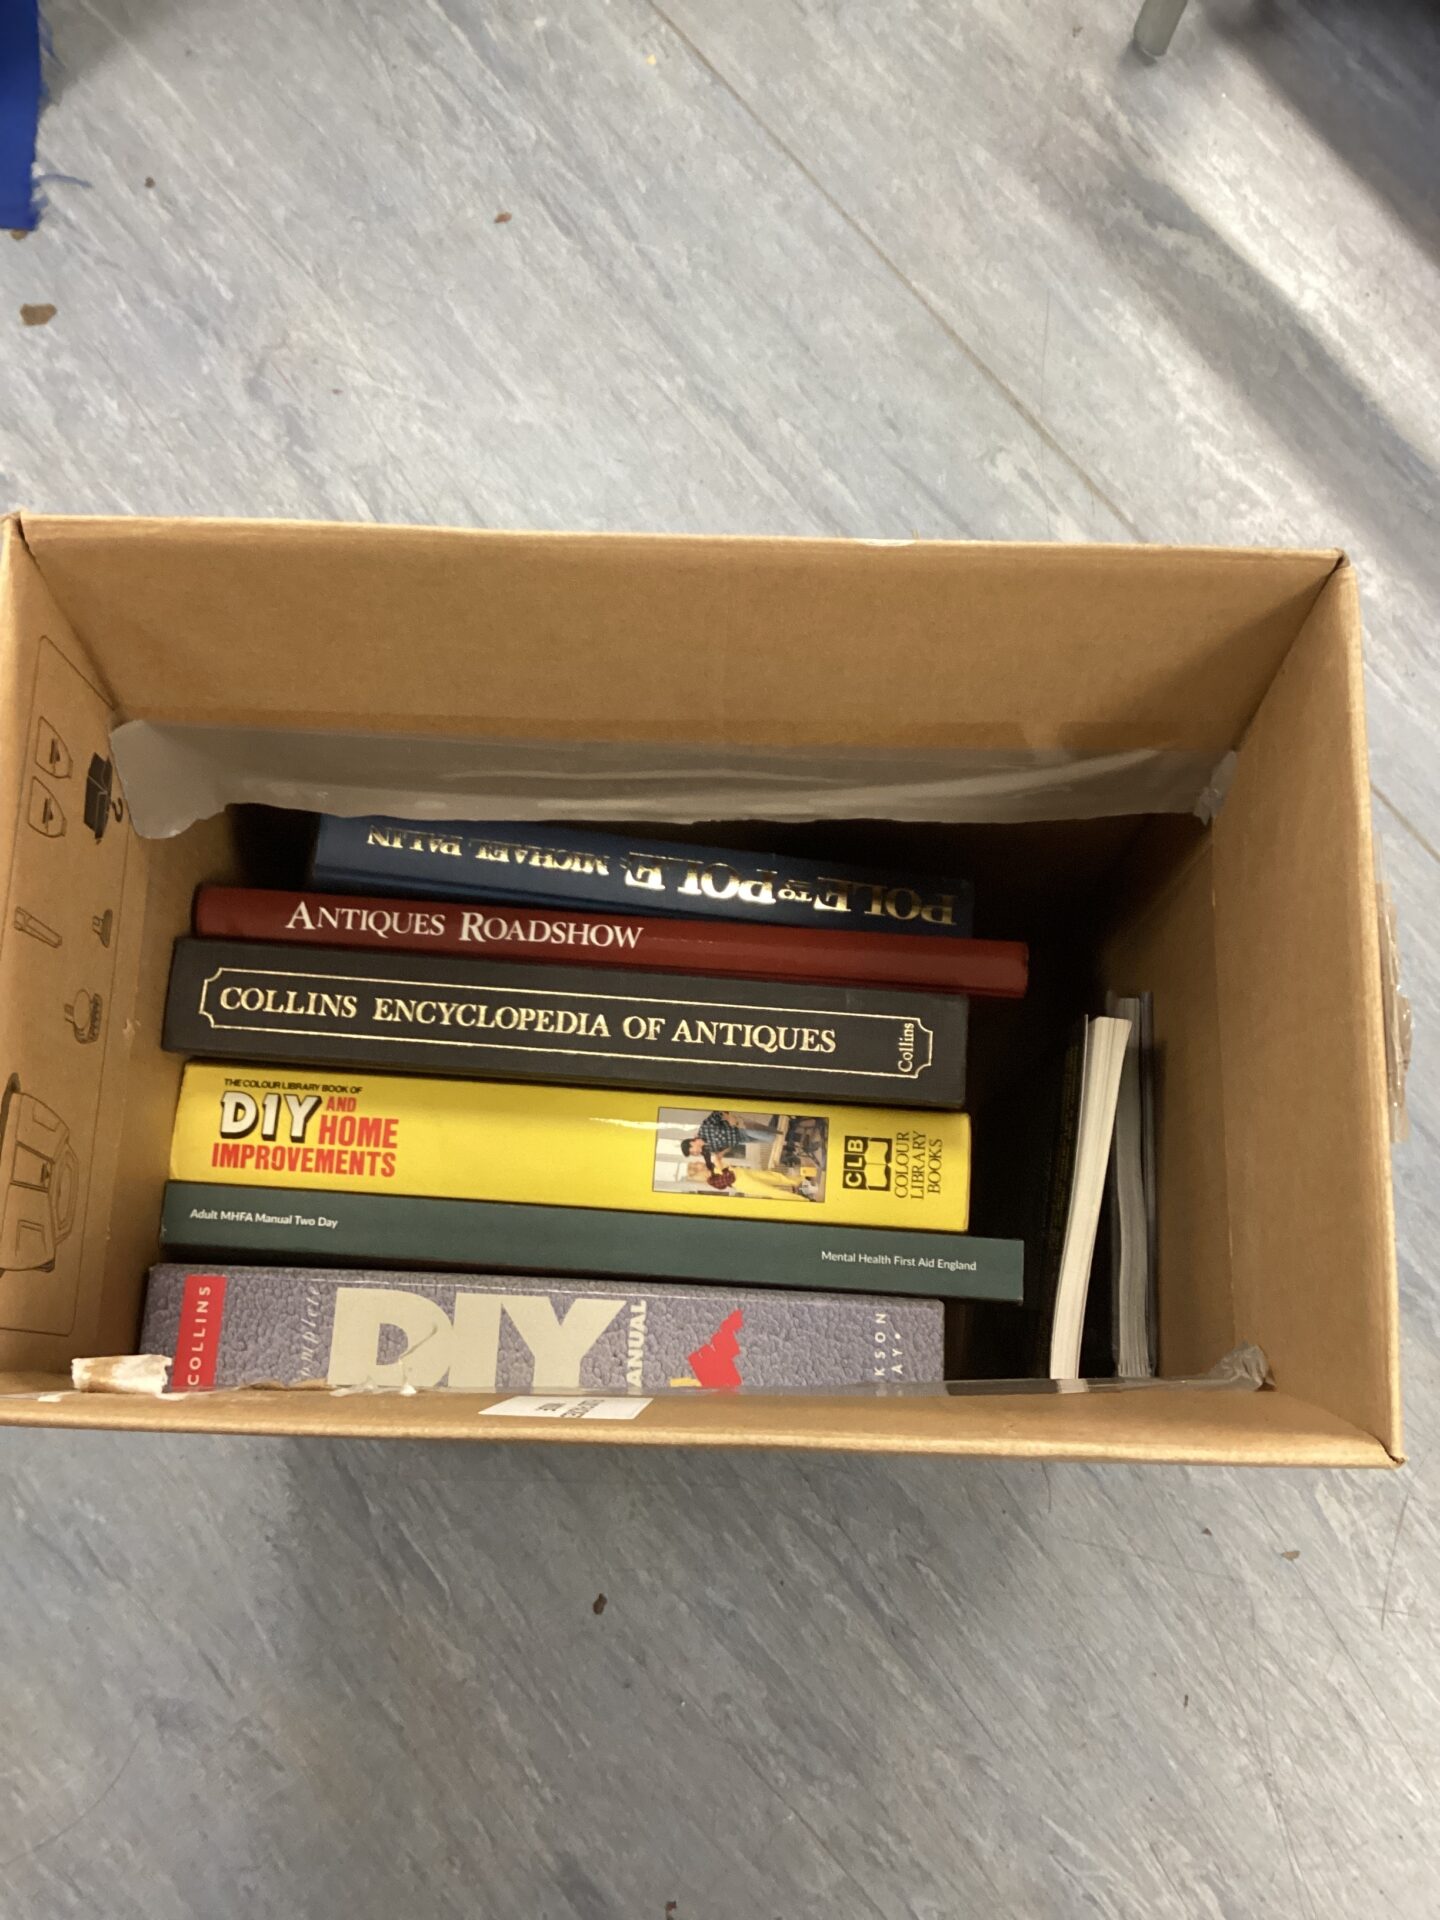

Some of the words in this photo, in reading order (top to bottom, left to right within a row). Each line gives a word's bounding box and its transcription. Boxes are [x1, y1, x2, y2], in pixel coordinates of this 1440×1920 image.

[367, 825, 463, 857] PALIN
[468, 838, 610, 876] MICHAEL
[620, 852, 777, 905] POLE
[814, 876, 957, 926] POLE
[285, 901, 445, 939] ANTIQUES
[459, 912, 644, 949] ROADSHOW
[220, 987, 357, 1018] COLLINS
[372, 997, 611, 1037] ENCYCLOPEDIA
[622, 1016, 665, 1040] OF
[672, 1020, 836, 1053] ANTIQUES
[898, 1022, 914, 1072] Collins
[224, 1078, 241, 1087] THE
[243, 1079, 281, 1089] COLOUR
[282, 1082, 321, 1091] LIBRARY
[322, 1085, 348, 1093] BOOK
[349, 1086, 362, 1094] OF
[220, 1090, 323, 1143] DIY
[326, 1096, 357, 1112] AND
[318, 1114, 399, 1148] HOME
[211, 1142, 396, 1178] IMPROVEMENTS
[845, 1139, 863, 1187] CLB
[894, 1131, 909, 1198] COLOUR
[911, 1130, 926, 1200] LIBRARY
[927, 1138, 943, 1194] BOOKS
[190, 1208, 217, 1220] Adult
[220, 1211, 253, 1222] MHFA
[255, 1213, 292, 1225] Manual
[295, 1215, 316, 1226] Two
[317, 1217, 338, 1229] Day
[821, 1250, 856, 1263] Mental
[858, 1253, 891, 1265] Health
[894, 1255, 916, 1267] First
[918, 1257, 934, 1268] Aid
[937, 1259, 977, 1271] England
[187, 1286, 211, 1385] COLLINS
[301, 1286, 320, 1376] omplete
[327, 1287, 627, 1392] DIY
[874, 1313, 886, 1377] KSON
